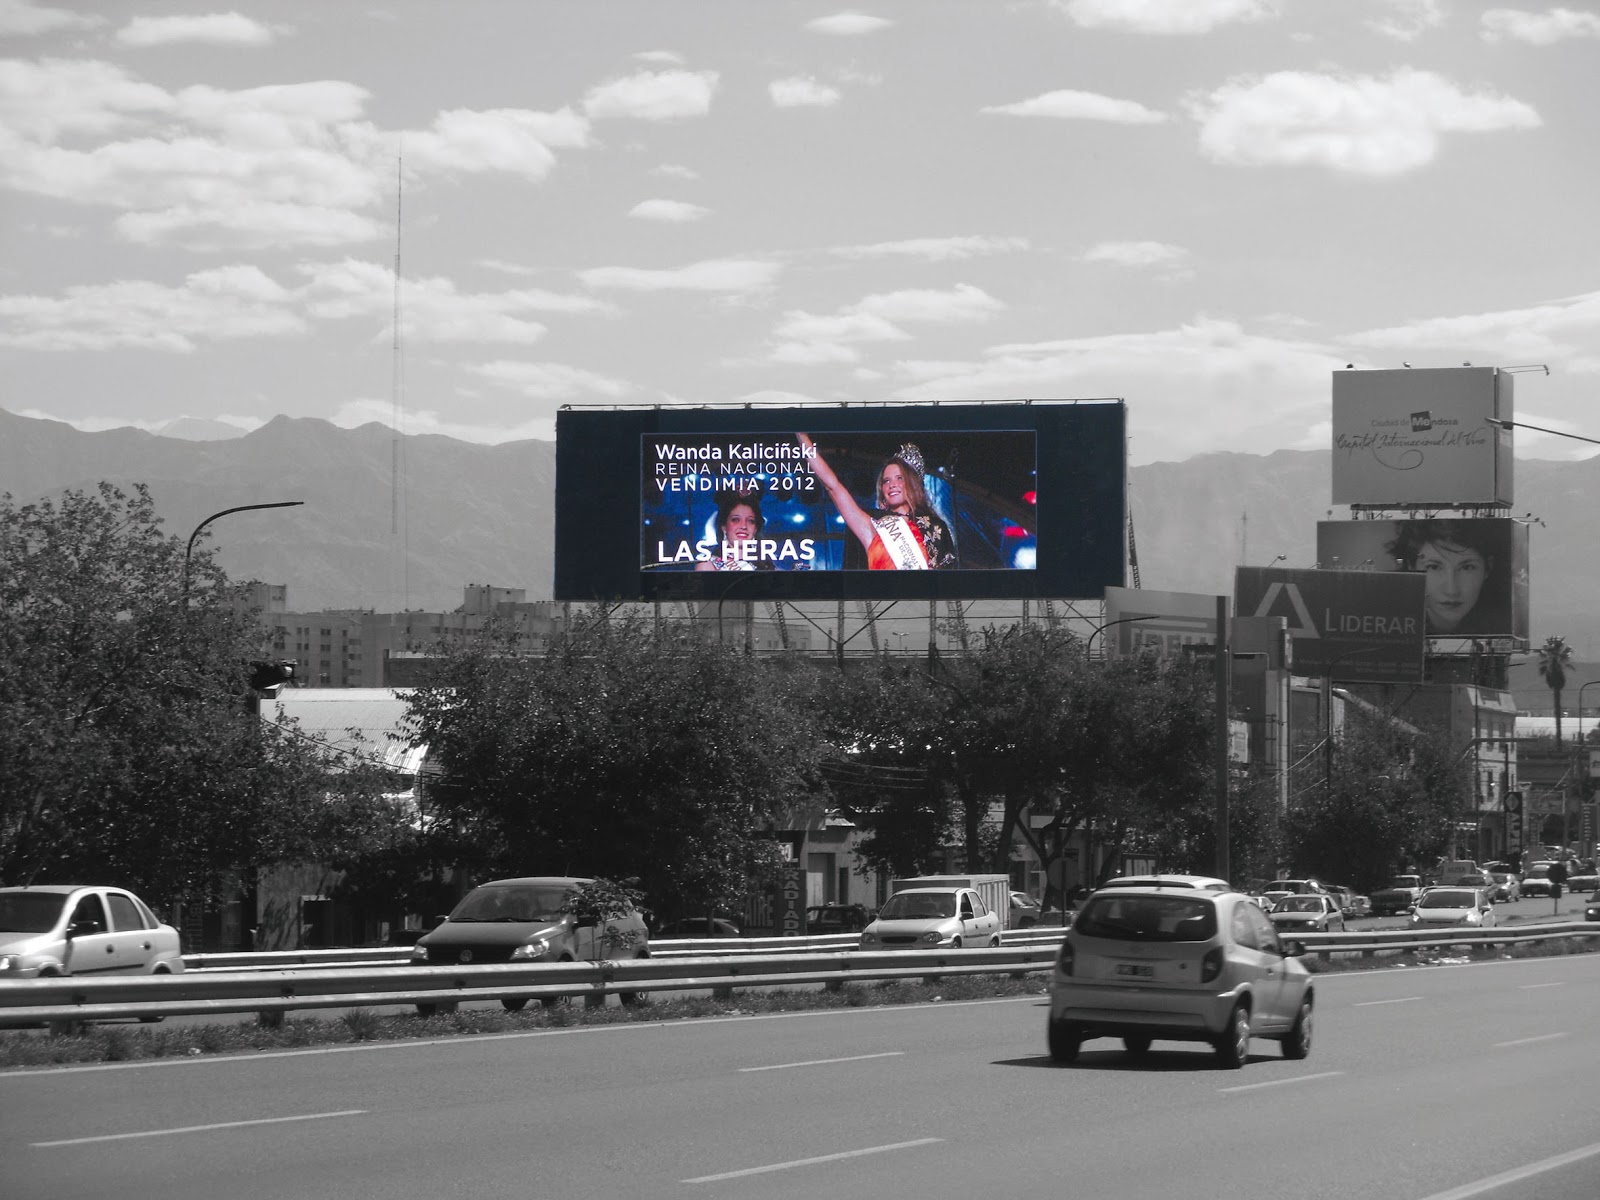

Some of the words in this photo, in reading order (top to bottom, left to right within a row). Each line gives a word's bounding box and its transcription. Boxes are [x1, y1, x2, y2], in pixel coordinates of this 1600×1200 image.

[1411, 414, 1458, 428] Mendoza
[655, 443, 722, 460] Wanda
[729, 442, 817, 460] Kaliciñski
[656, 463, 711, 475] REINA
[720, 462, 816, 475] NACIONAL
[656, 477, 760, 492] VENDIMIA
[769, 476, 815, 491] 2012
[658, 540, 712, 562] LAS
[721, 539, 816, 562] HERAS
[1325, 607, 1417, 634] LIDERAR
